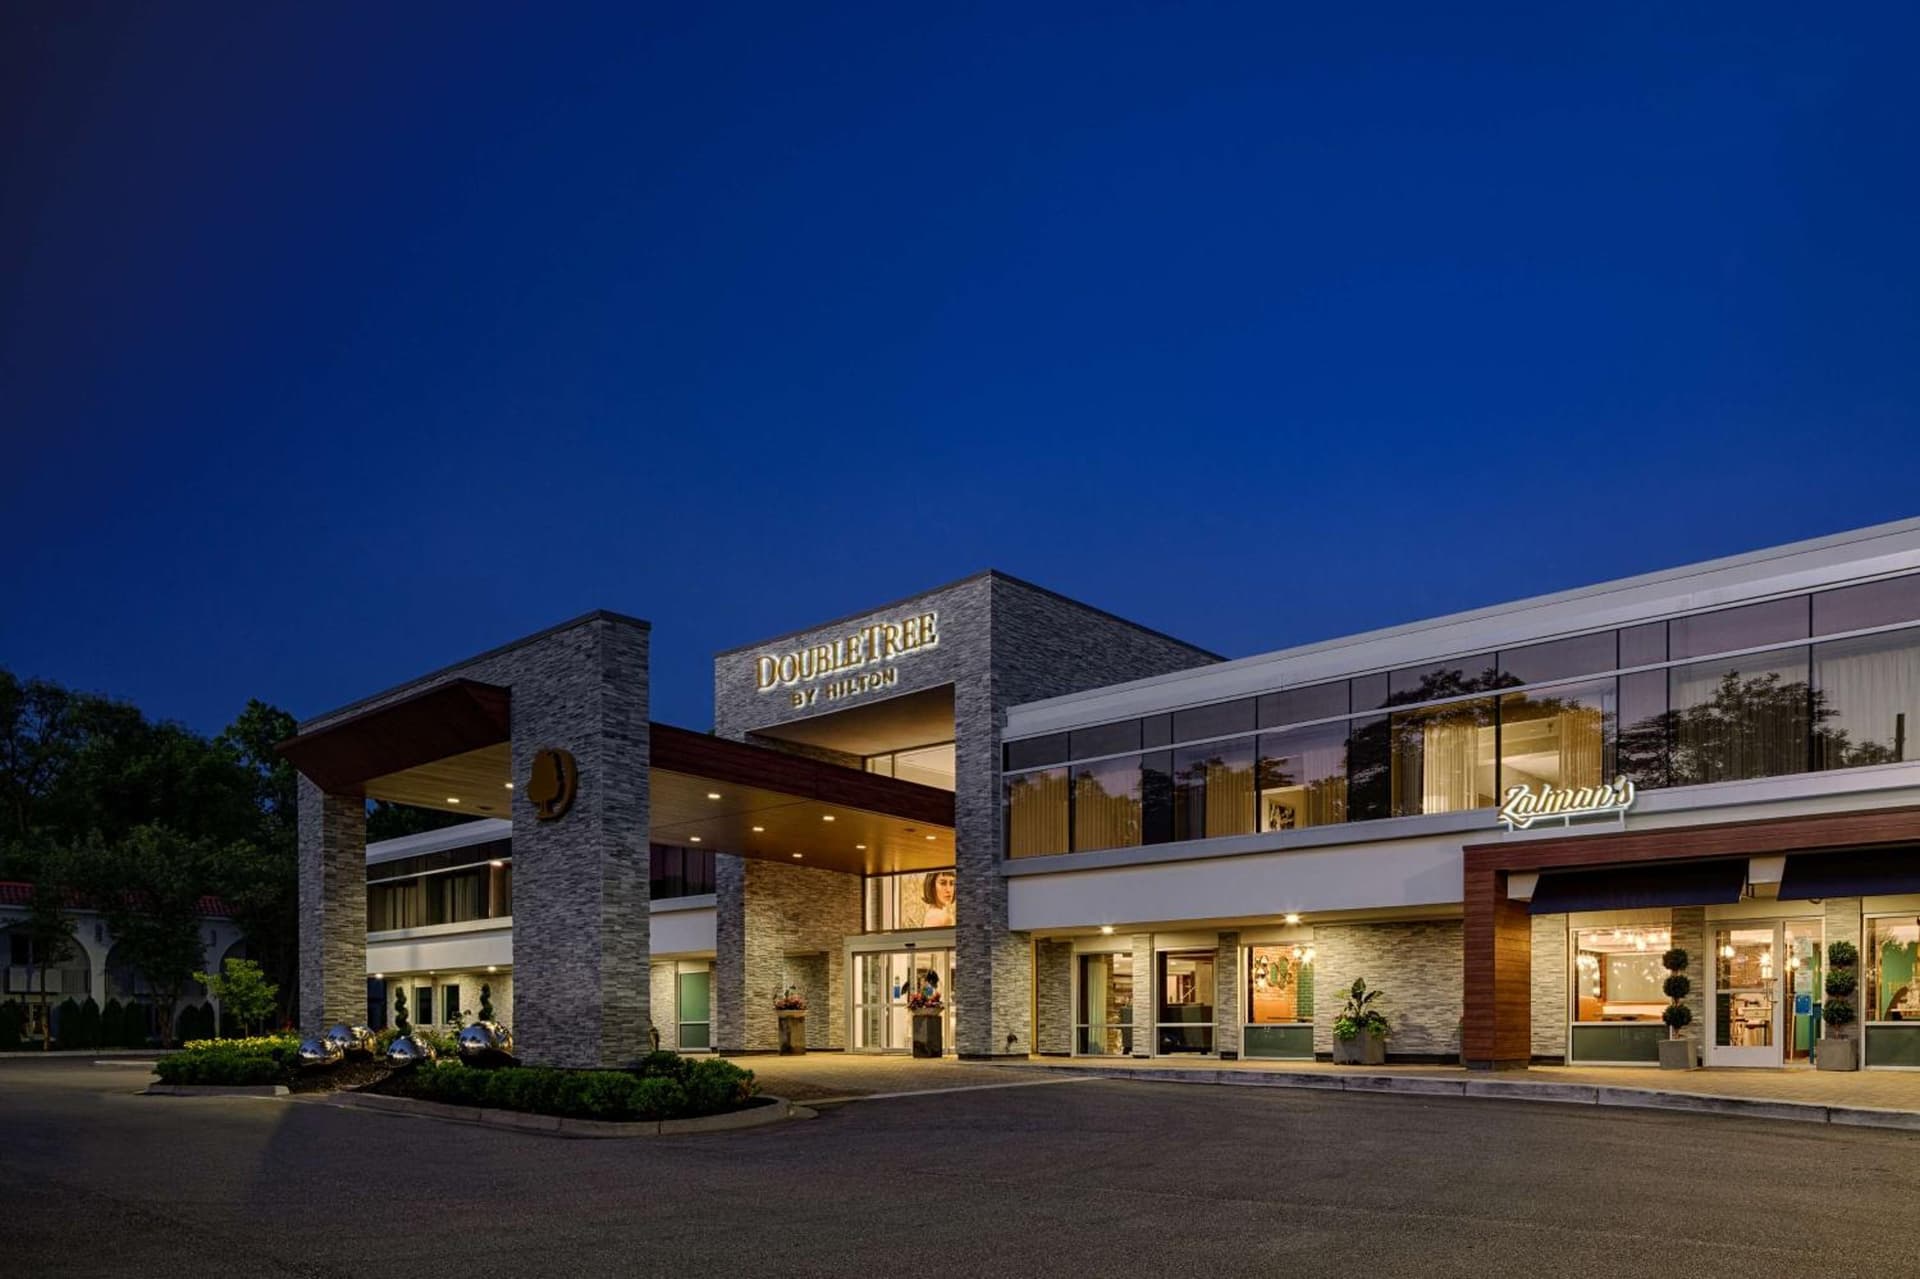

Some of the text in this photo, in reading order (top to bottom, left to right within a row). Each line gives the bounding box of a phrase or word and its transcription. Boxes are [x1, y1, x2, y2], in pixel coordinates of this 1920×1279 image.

[756, 612, 938, 691] DOUBLETREE
[791, 667, 898, 709] BY HILTON
[1497, 775, 1634, 828] Zalman's
